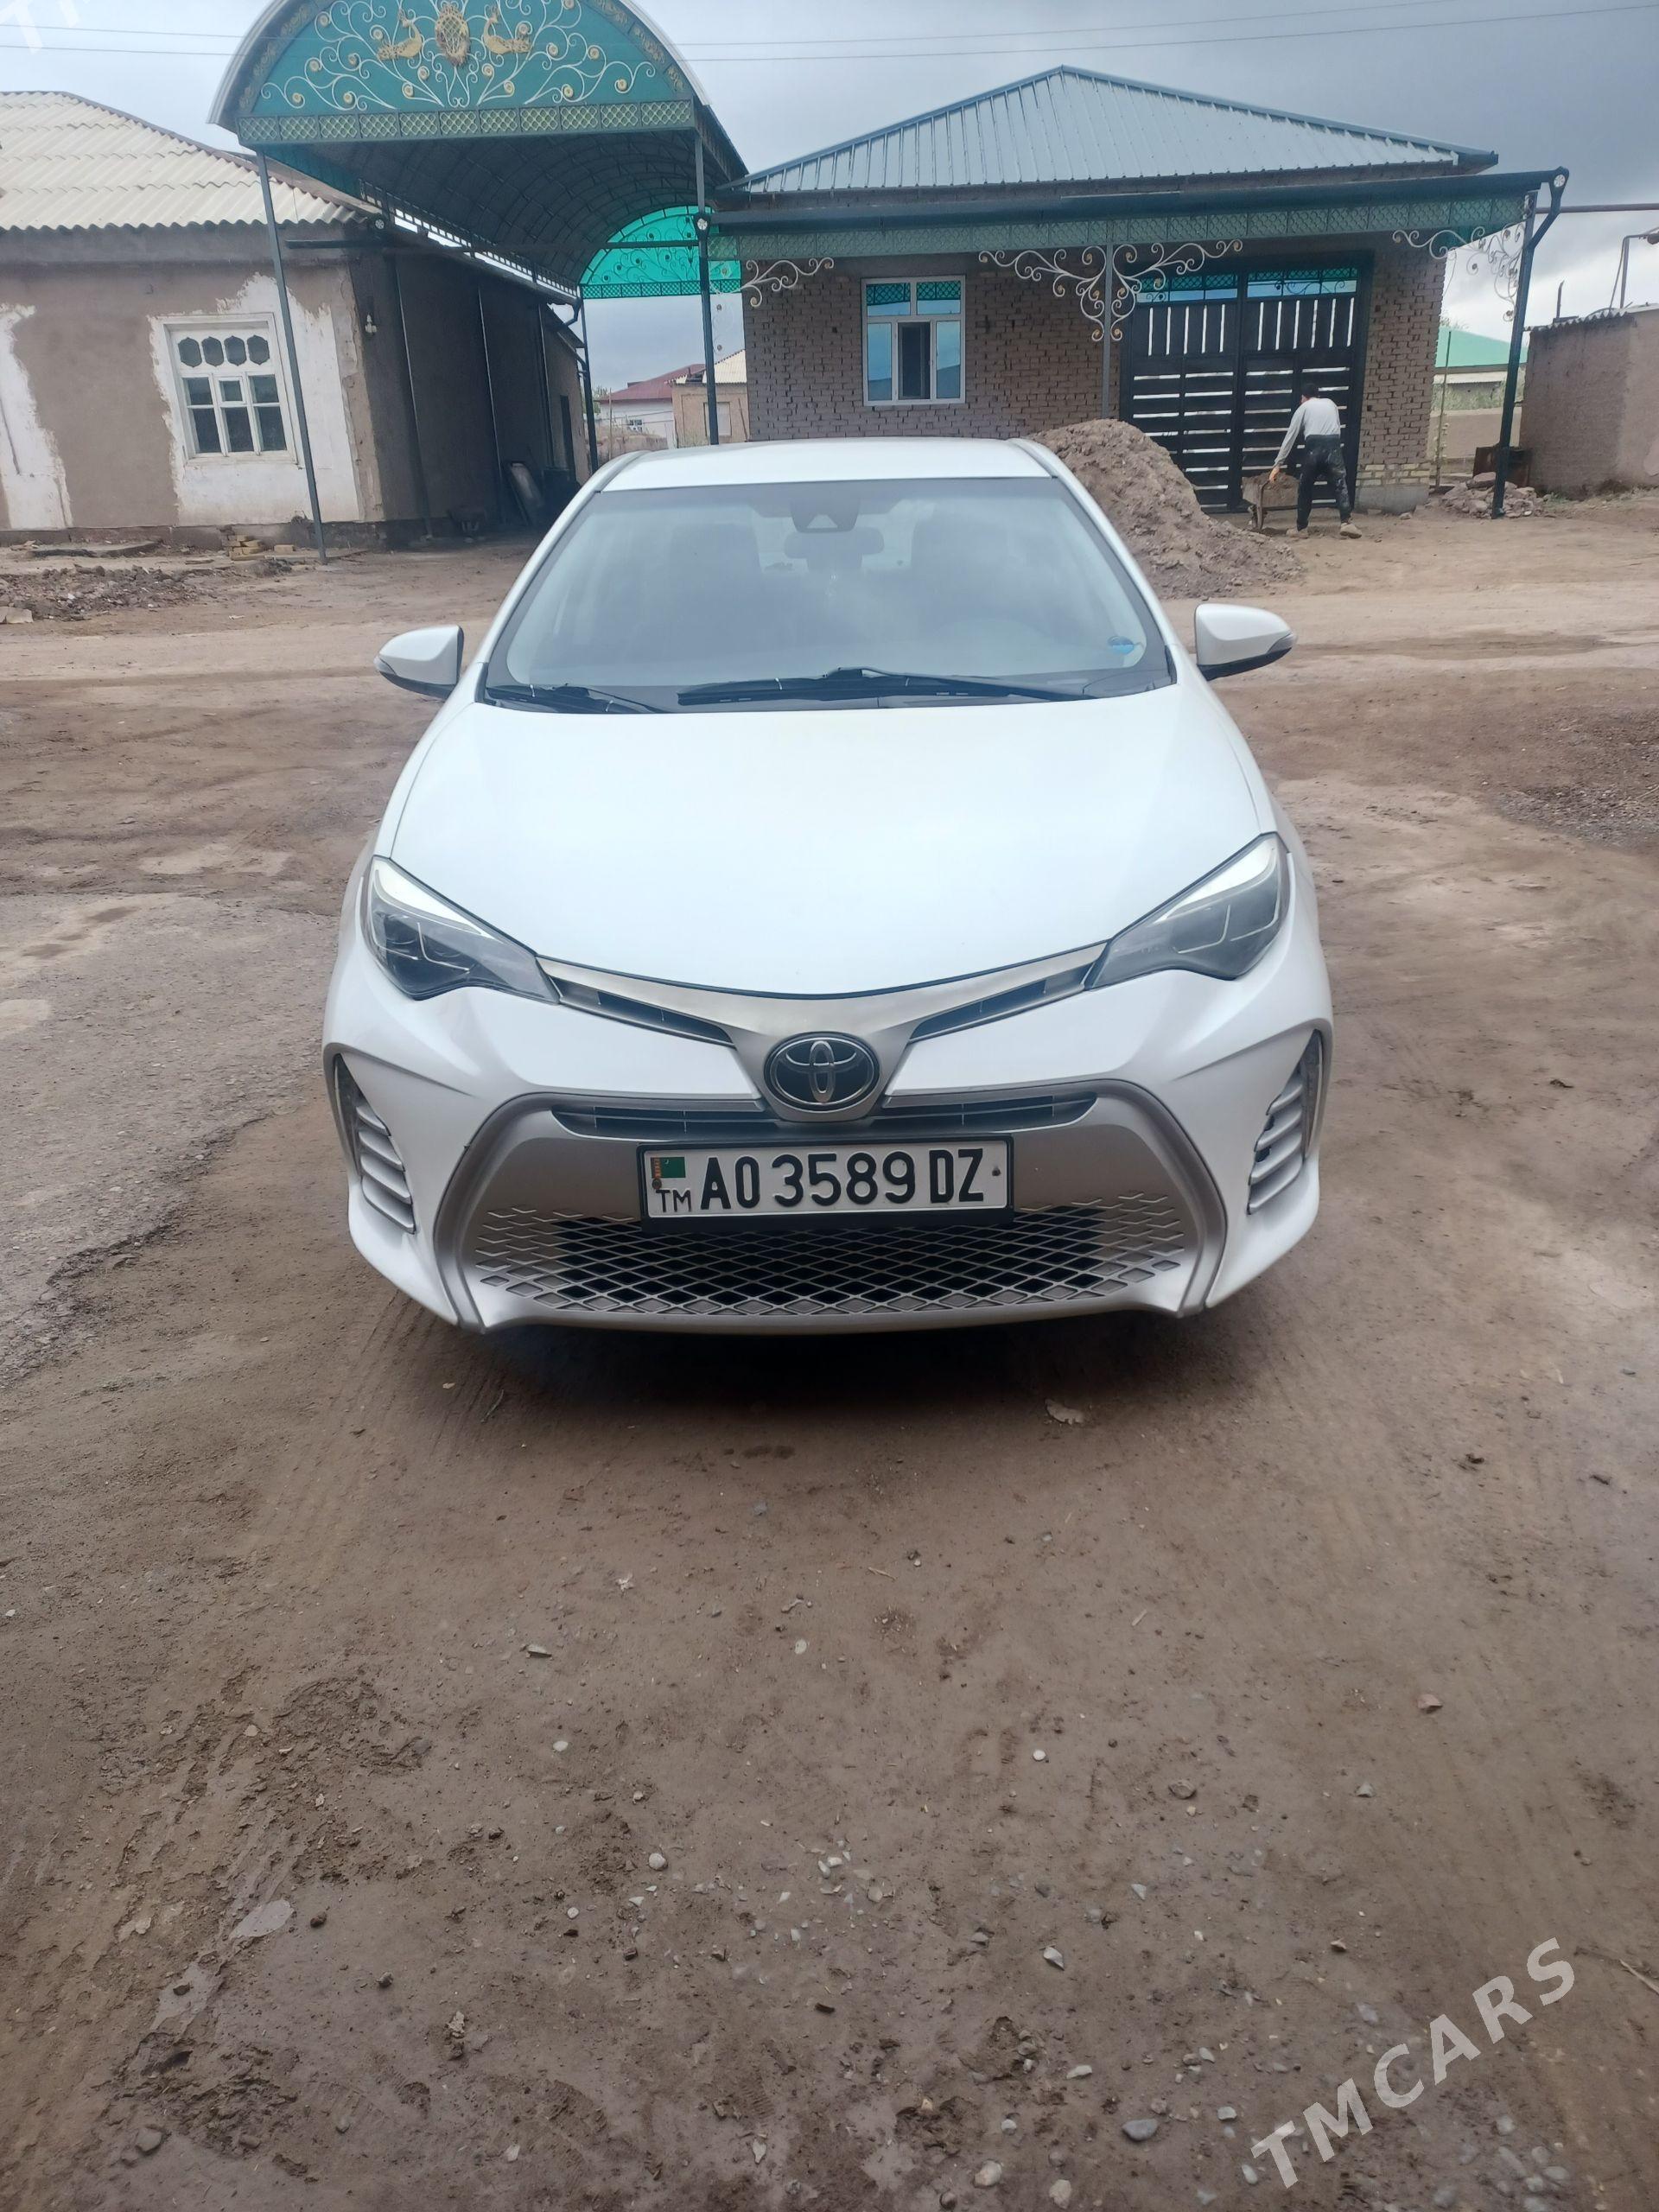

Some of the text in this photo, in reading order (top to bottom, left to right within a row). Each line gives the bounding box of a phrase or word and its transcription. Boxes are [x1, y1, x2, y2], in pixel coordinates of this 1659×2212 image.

[771, 1151, 916, 1207] 3589
[929, 1147, 984, 1203] DZ
[655, 1189, 692, 1212] TM
